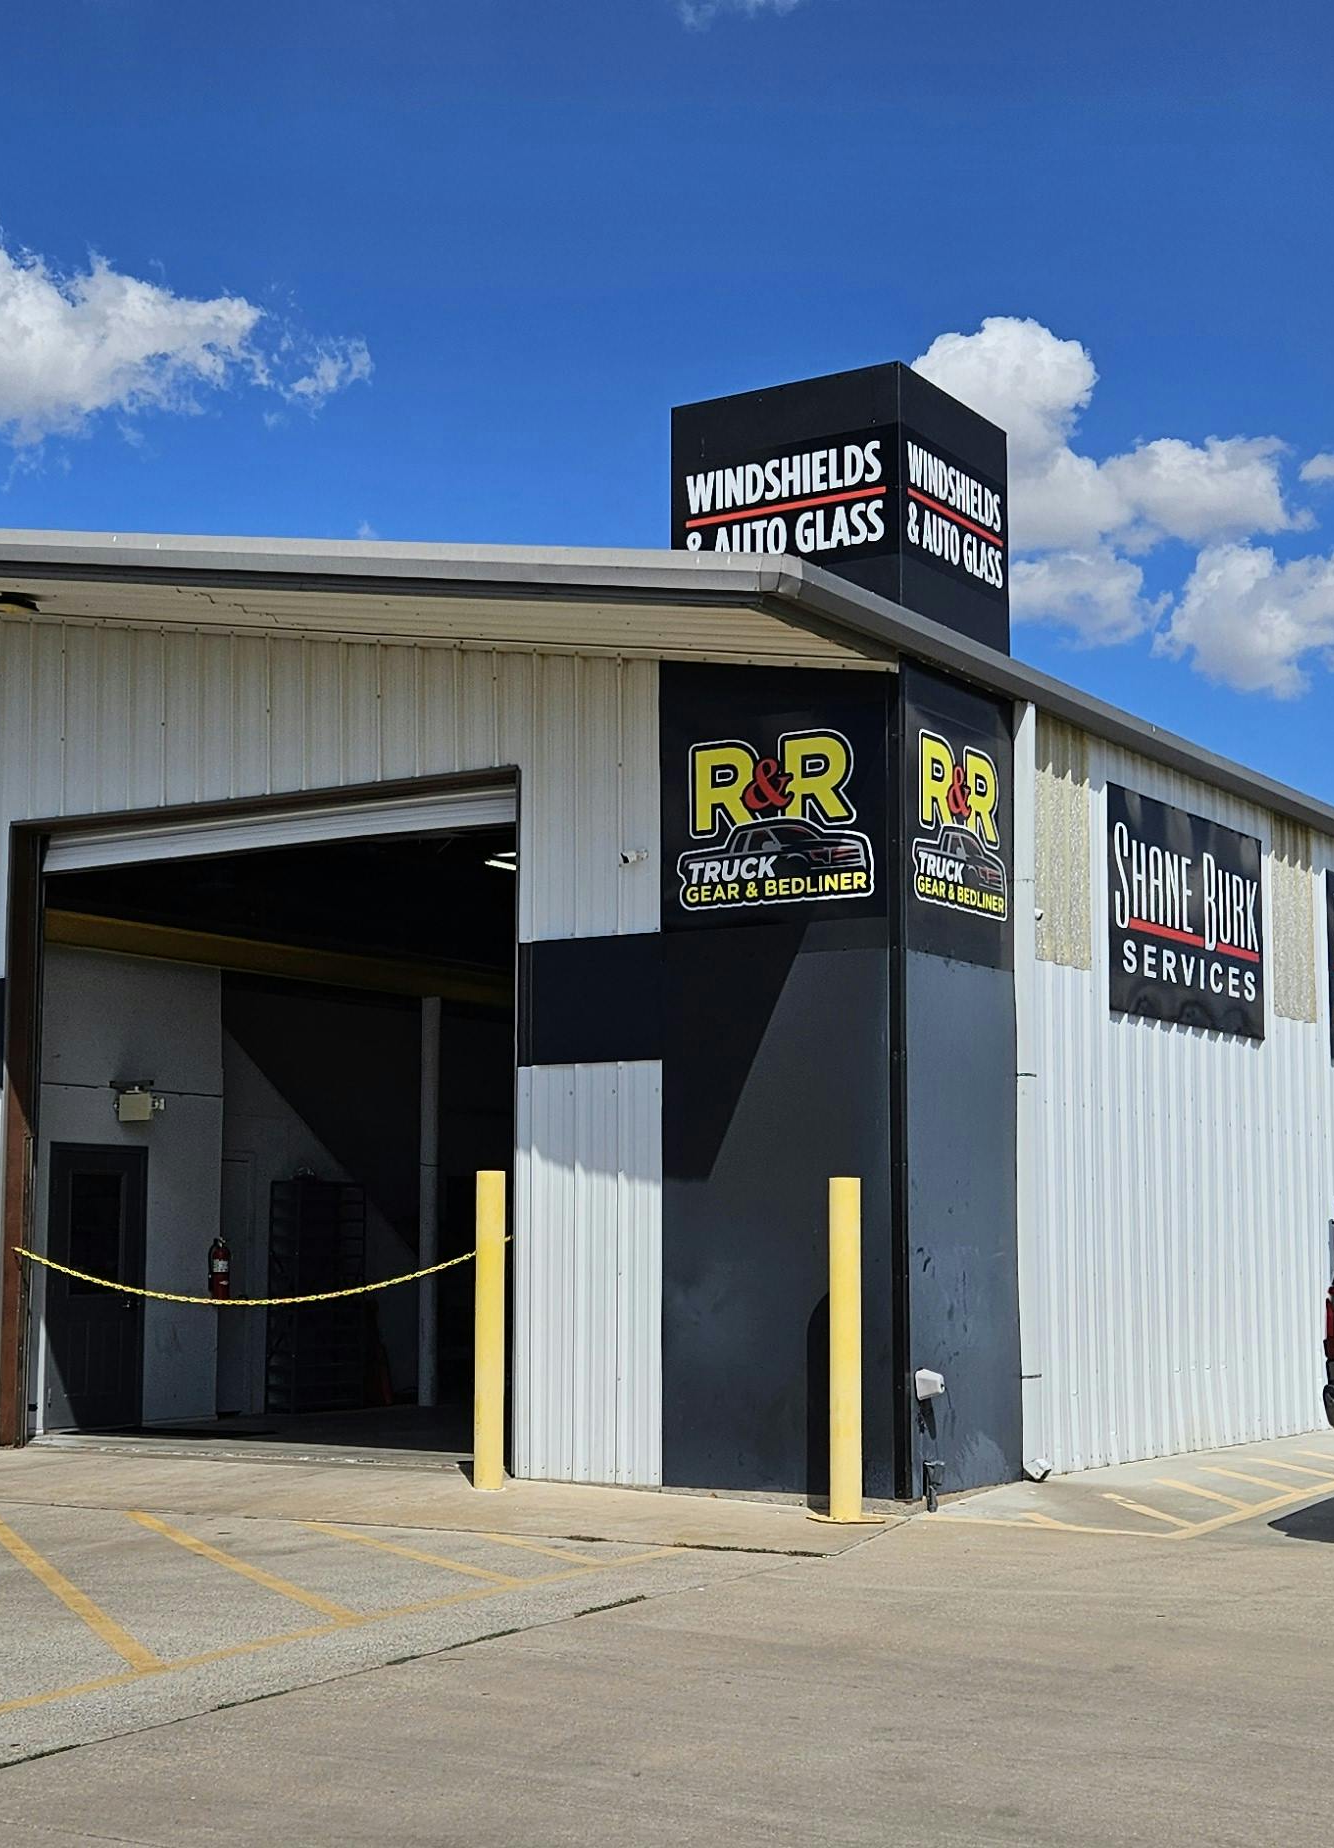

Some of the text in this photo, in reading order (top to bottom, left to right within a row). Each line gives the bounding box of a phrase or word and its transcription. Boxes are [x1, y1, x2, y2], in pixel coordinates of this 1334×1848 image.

[685, 440, 882, 515] WINDSHIELDS
[907, 441, 1001, 534] WINDSHIELDS
[714, 516, 787, 555] AUTO
[795, 499, 885, 554] GLASS
[907, 501, 1004, 590] & AUTO GLASS
[694, 736, 849, 832] R&R
[922, 736, 998, 844] R&R
[686, 871, 868, 903] GEAR & BEDLINER
[688, 854, 778, 885] TRUCK
[917, 875, 1005, 914] GEAR & BEDLINER
[918, 850, 965, 885] TRUCK
[1113, 821, 1260, 952] SHANE BURK
[1122, 939, 1258, 1002] SERVICES
